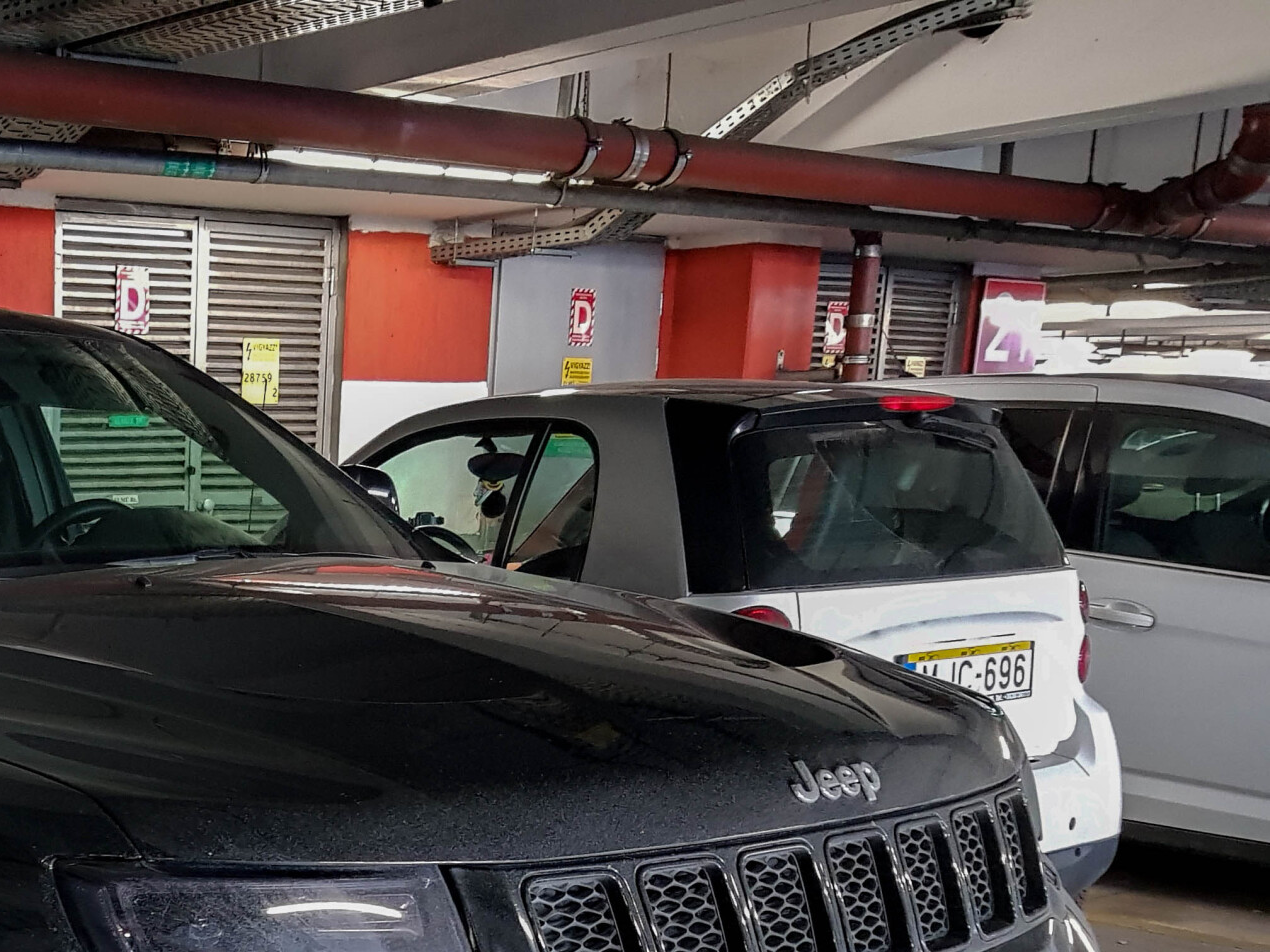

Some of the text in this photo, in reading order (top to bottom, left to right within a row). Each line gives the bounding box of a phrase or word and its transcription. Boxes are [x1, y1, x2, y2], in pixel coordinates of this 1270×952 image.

[121, 281, 146, 320] D
[573, 300, 592, 334] D
[244, 373, 273, 383] 28759
[272, 388, 278, 397] 2
[791, 760, 880, 803] Jeep
